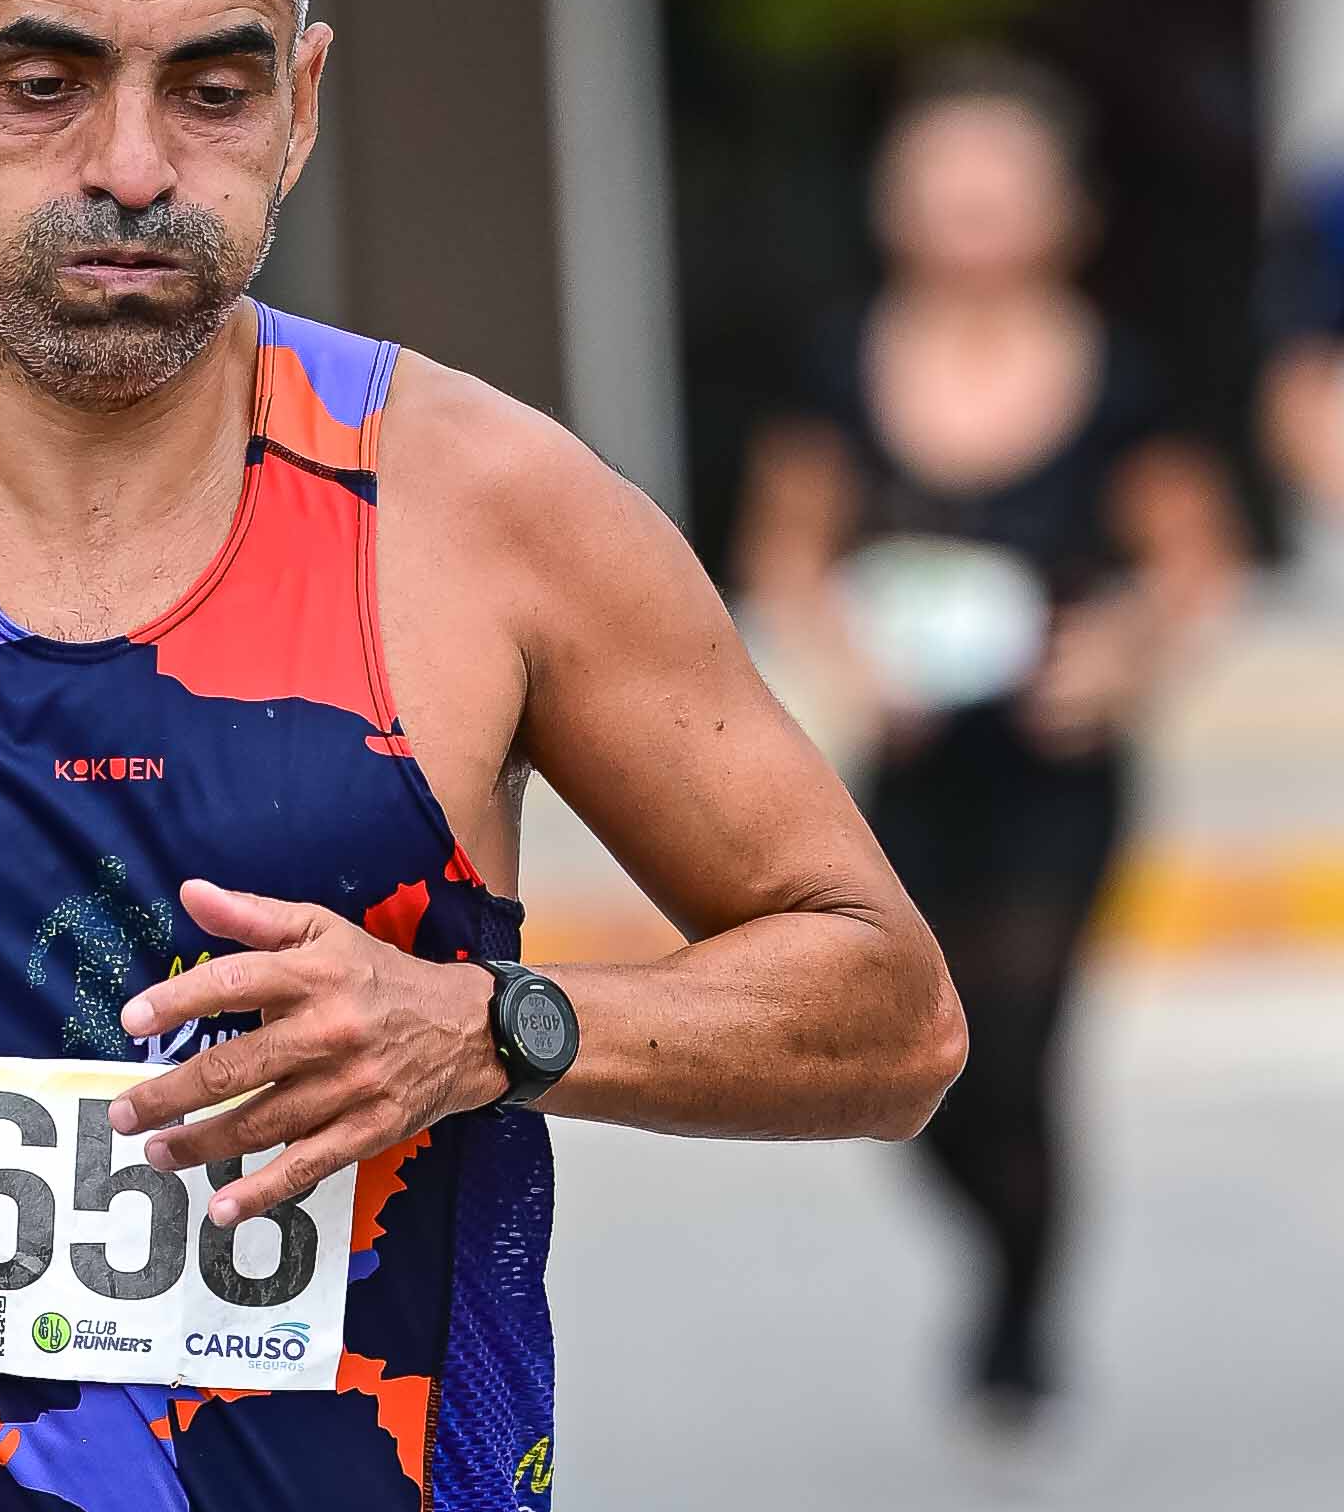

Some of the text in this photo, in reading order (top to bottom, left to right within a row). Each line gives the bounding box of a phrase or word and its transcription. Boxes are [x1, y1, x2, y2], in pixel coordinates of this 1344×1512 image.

[55, 758, 164, 781] KOKUEN
[76, 1319, 116, 1335] CLUB
[73, 1334, 152, 1353] RUNNER'S
[185, 1333, 306, 1361] CARUSO
[248, 1360, 305, 1372] SEGUROS
